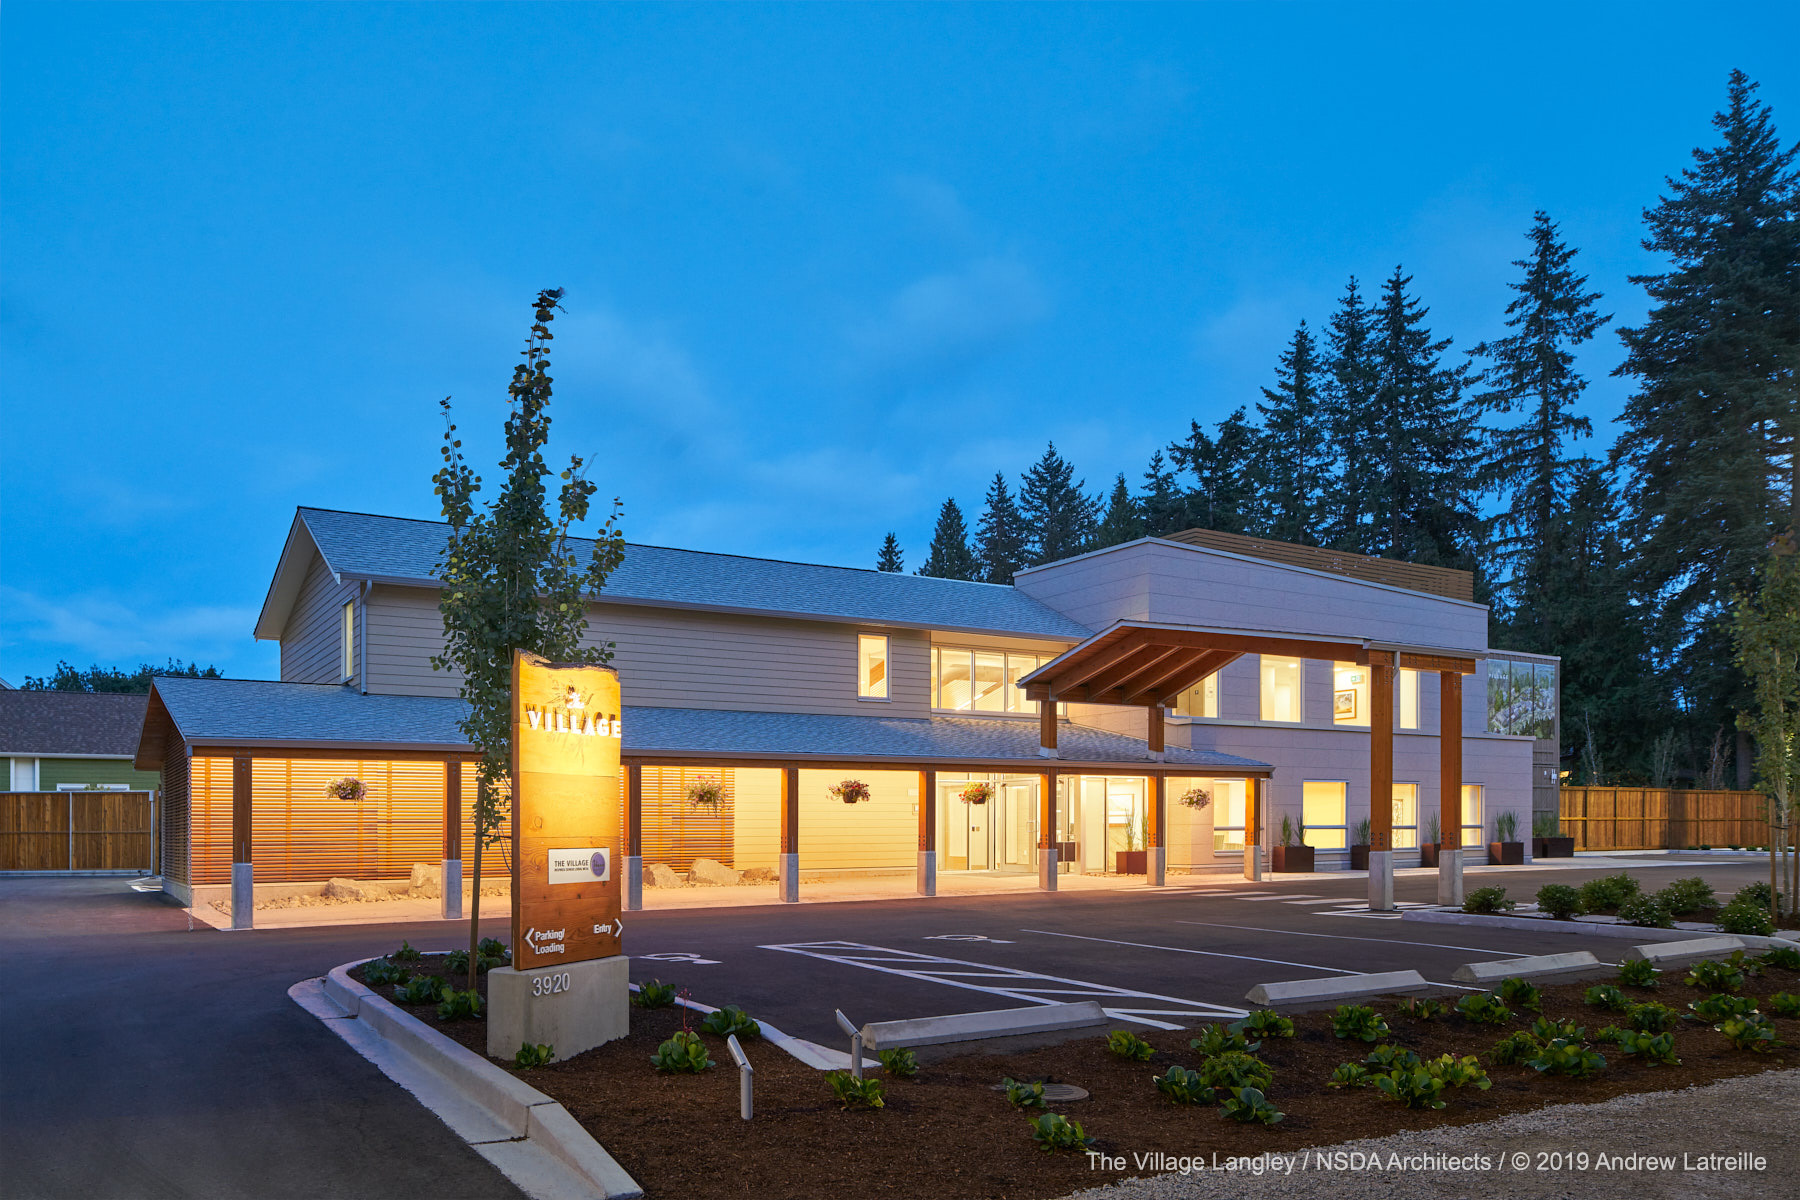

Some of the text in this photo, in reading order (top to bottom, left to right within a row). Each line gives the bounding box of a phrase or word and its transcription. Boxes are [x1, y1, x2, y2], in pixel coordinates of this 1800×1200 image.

[527, 710, 622, 739] VILLAGE
[566, 859, 589, 867] VILLAGE
[593, 923, 612, 934] Entry
[535, 943, 565, 955] Loading
[532, 972, 570, 997] 3920
